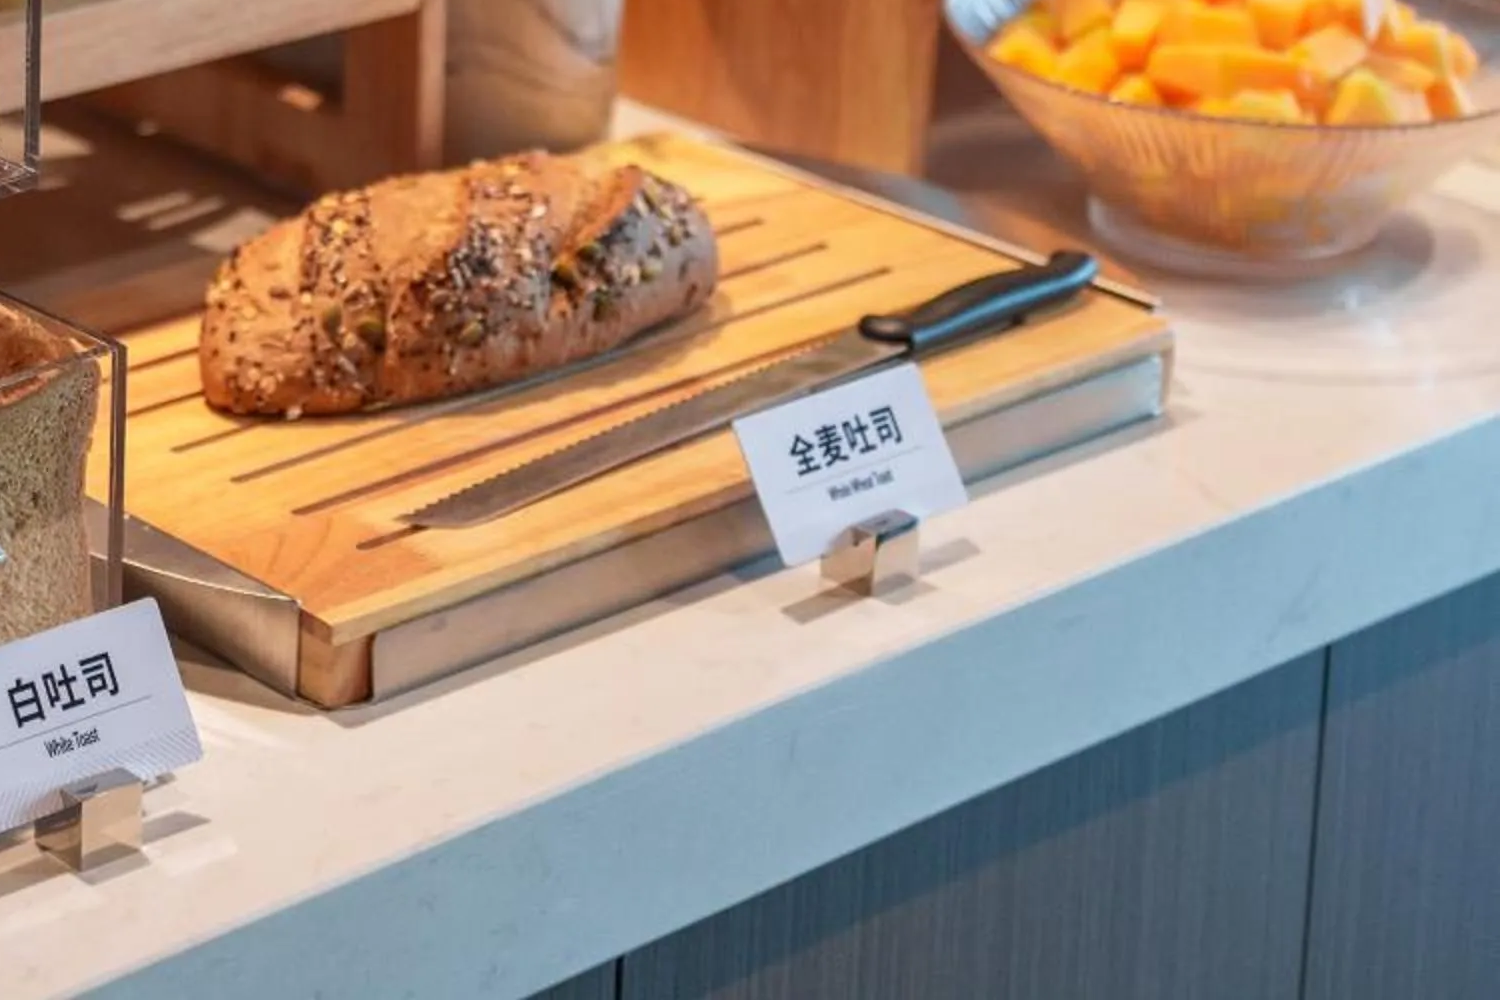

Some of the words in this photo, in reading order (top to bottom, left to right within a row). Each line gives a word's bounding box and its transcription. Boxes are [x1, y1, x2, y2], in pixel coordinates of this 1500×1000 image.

[789, 405, 903, 476] 全麦吐司
[7, 651, 120, 728] 白吐司
[43, 736, 75, 758] White
[72, 727, 101, 749] Toast
